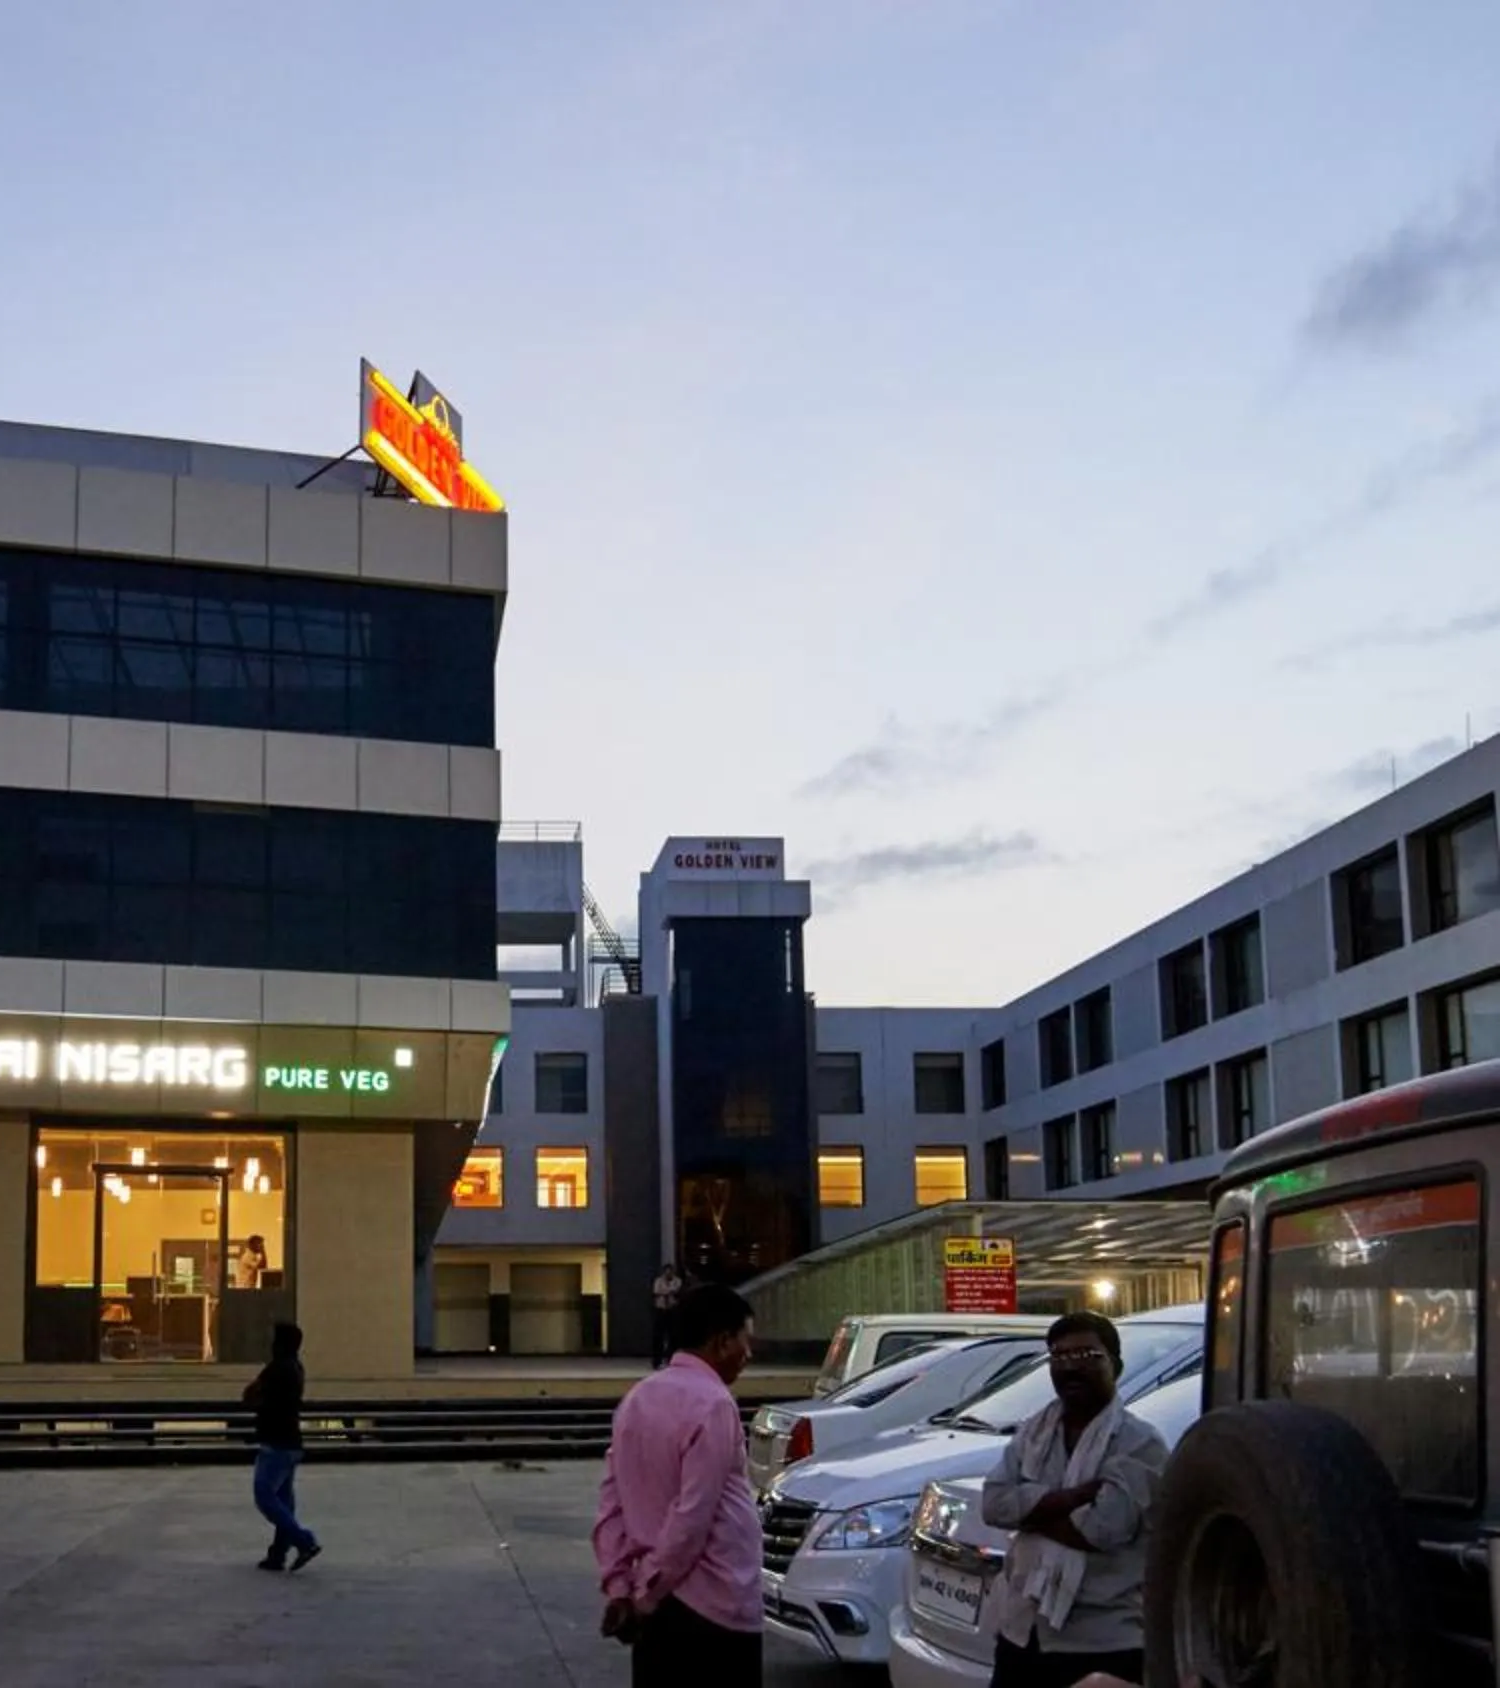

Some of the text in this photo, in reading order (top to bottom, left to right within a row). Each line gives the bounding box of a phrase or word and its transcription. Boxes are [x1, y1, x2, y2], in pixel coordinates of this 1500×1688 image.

[706, 840, 741, 851] HOTEL
[674, 854, 777, 870] GOLDEN VIEW
[57, 1042, 246, 1088] NISARG
[265, 1067, 389, 1091] PURE VEG
